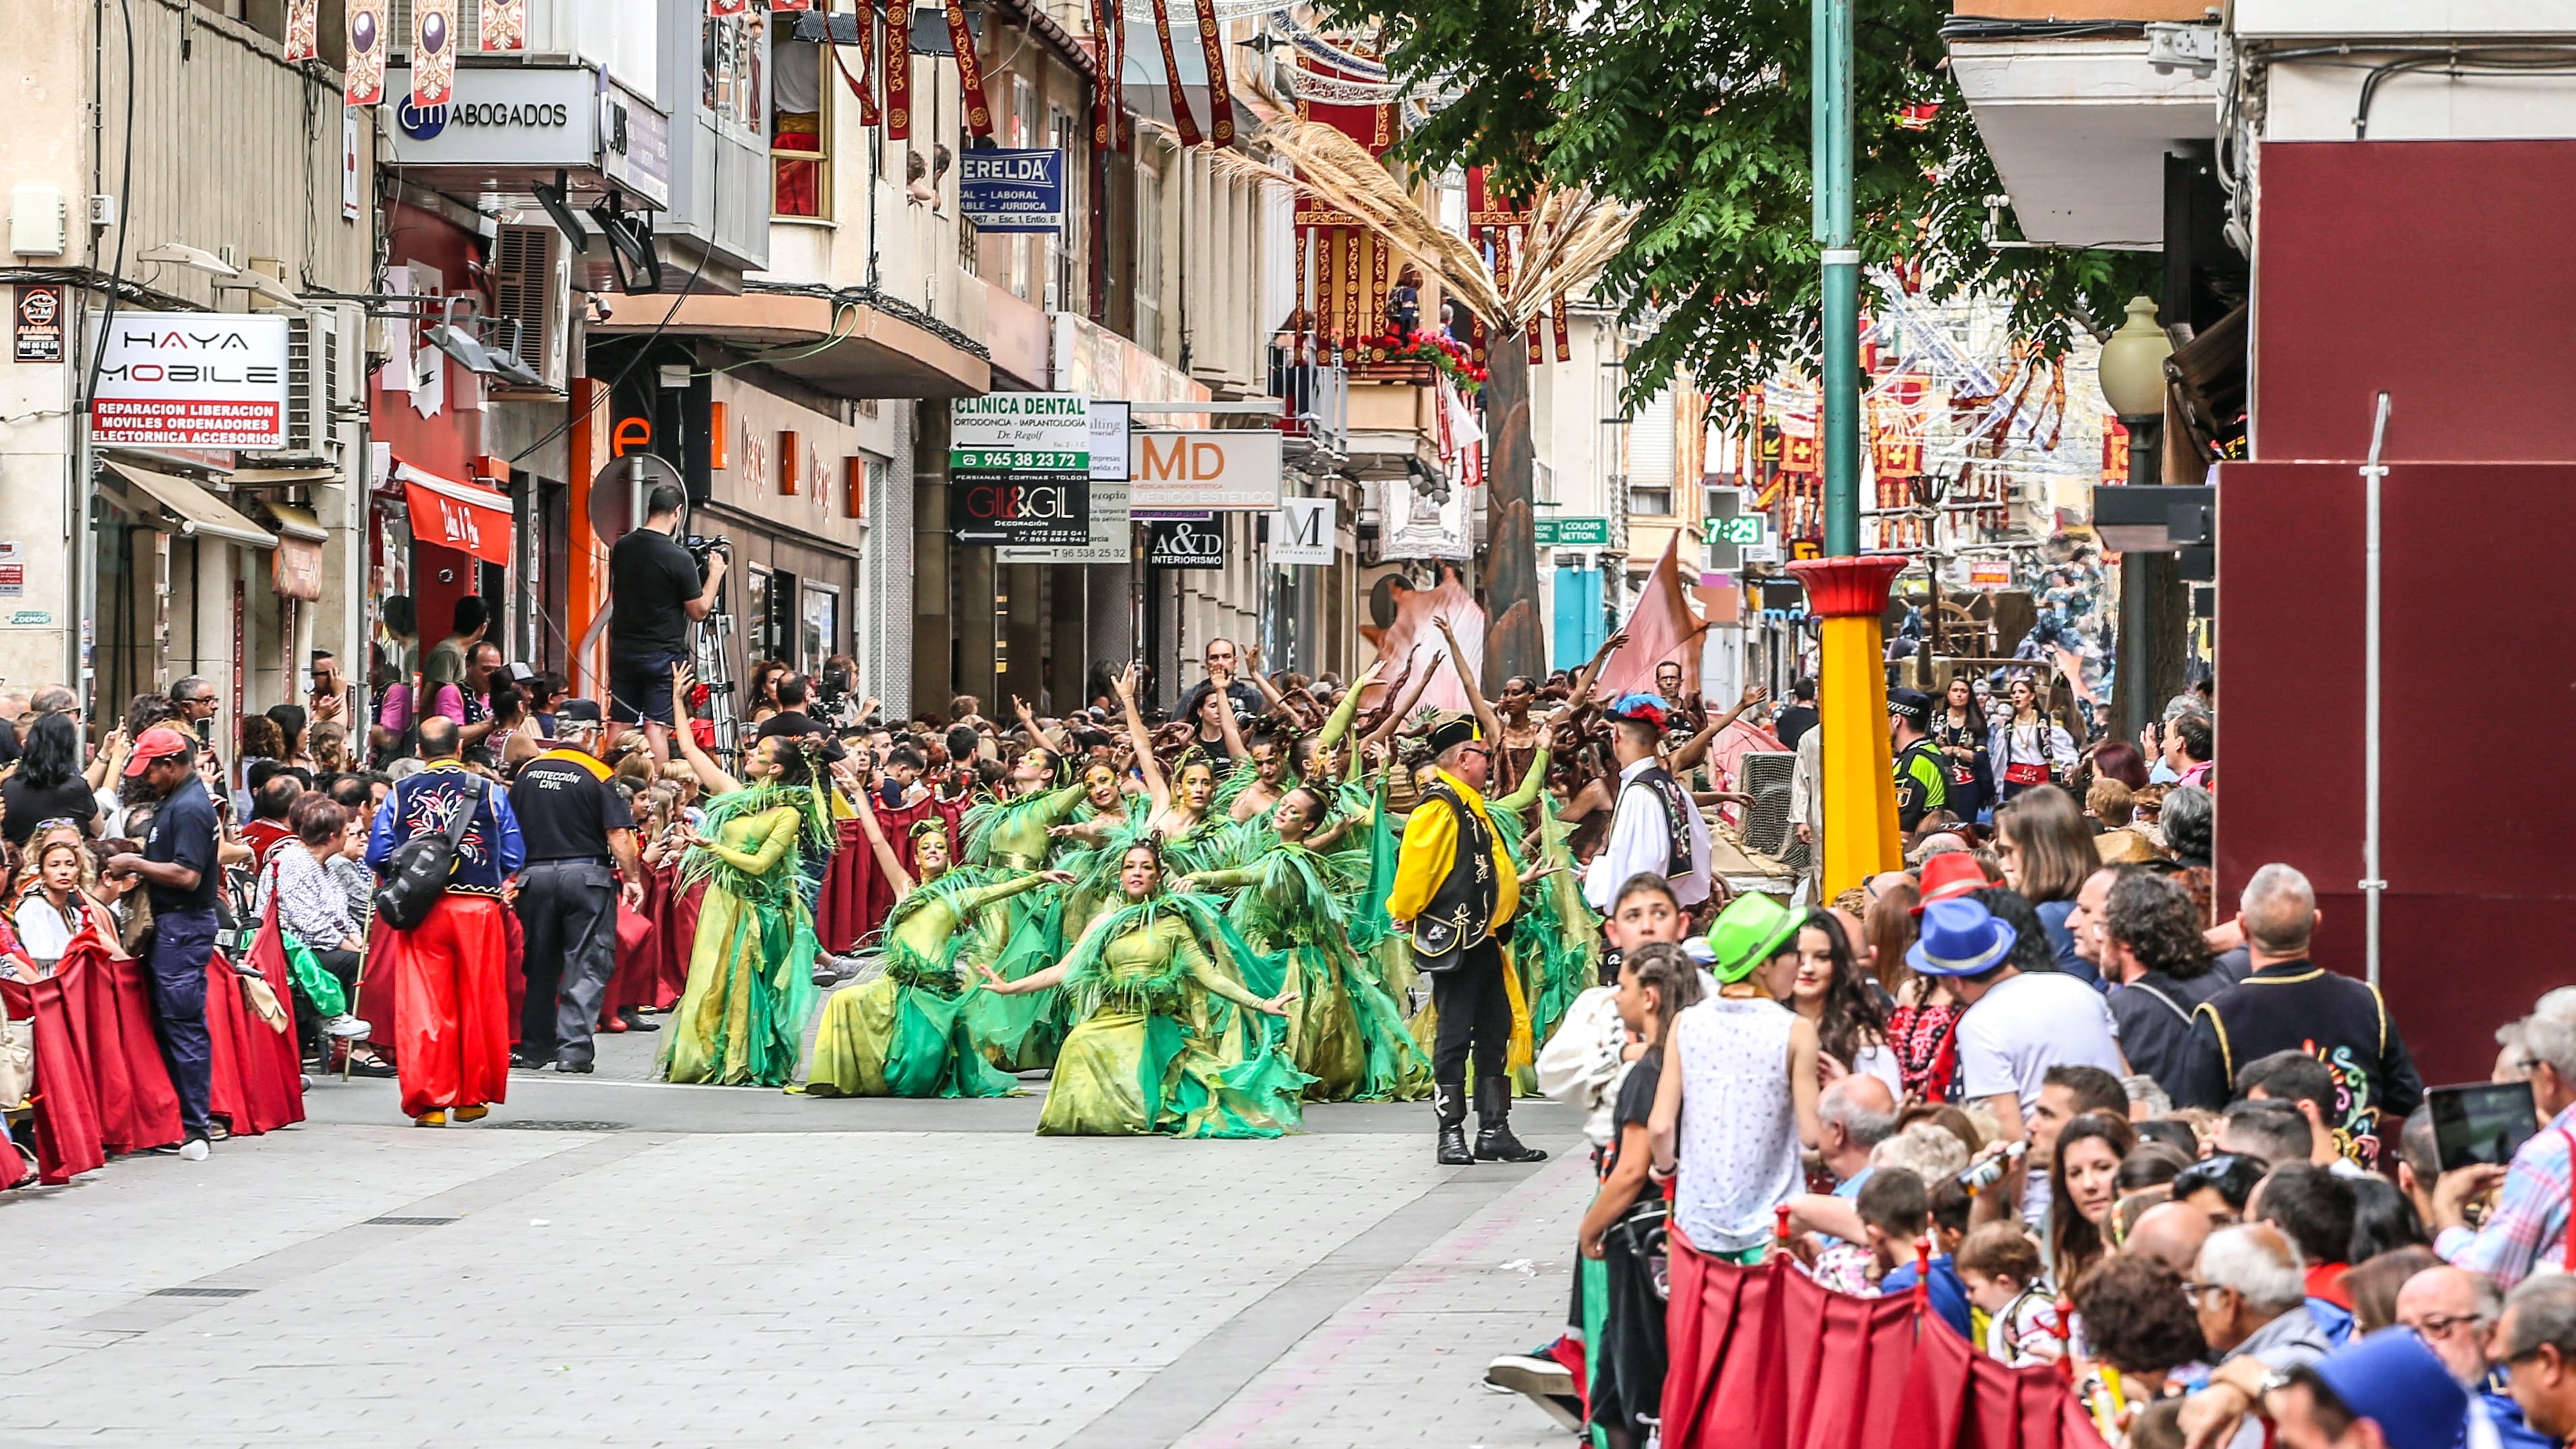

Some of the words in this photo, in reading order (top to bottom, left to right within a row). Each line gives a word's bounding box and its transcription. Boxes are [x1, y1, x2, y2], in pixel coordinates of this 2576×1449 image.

[450, 103, 567, 127] ABOGADOS
[990, 191, 1039, 200] LABORAL
[1000, 202, 1046, 210] JURIDICA
[1050, 215, 1057, 223] B
[124, 331, 248, 350] HAYA
[99, 364, 278, 383] MOBILE
[98, 403, 186, 416] REPARACION
[190, 405, 274, 417] LIBERACION
[955, 398, 1019, 414] CLINICA
[1025, 398, 1086, 415] DENTAL
[102, 418, 163, 429] MOVILES
[167, 418, 270, 430] ORDENADORES
[953, 418, 1011, 426] ORTODONCIA
[1019, 418, 1087, 428] IMPLANTOLOGÍA
[91, 431, 188, 443] ELECTORNICA
[191, 432, 279, 445] ACCESORIOS
[613, 417, 651, 457] e
[997, 430, 1011, 440] Dr.
[1015, 430, 1044, 441] Regolf
[984, 453, 1011, 465] 965
[1014, 453, 1033, 466] 38
[1036, 453, 1055, 467] 23
[1057, 453, 1076, 467] 72
[967, 486, 1075, 518] GIL&GIL
[1279, 506, 1324, 547] M
[1565, 521, 1602, 530] COLORS
[1152, 523, 1223, 555] A&D
[1053, 549, 1059, 557] T
[1062, 549, 1074, 557] 96
[1077, 549, 1095, 558] 538
[1098, 549, 1111, 557] 25
[1114, 549, 1126, 557] 32
[1151, 555, 1222, 565] INTERIORISMO
[526, 770, 581, 784] PROTECCIÓN
[538, 779, 562, 791] CIVIL
